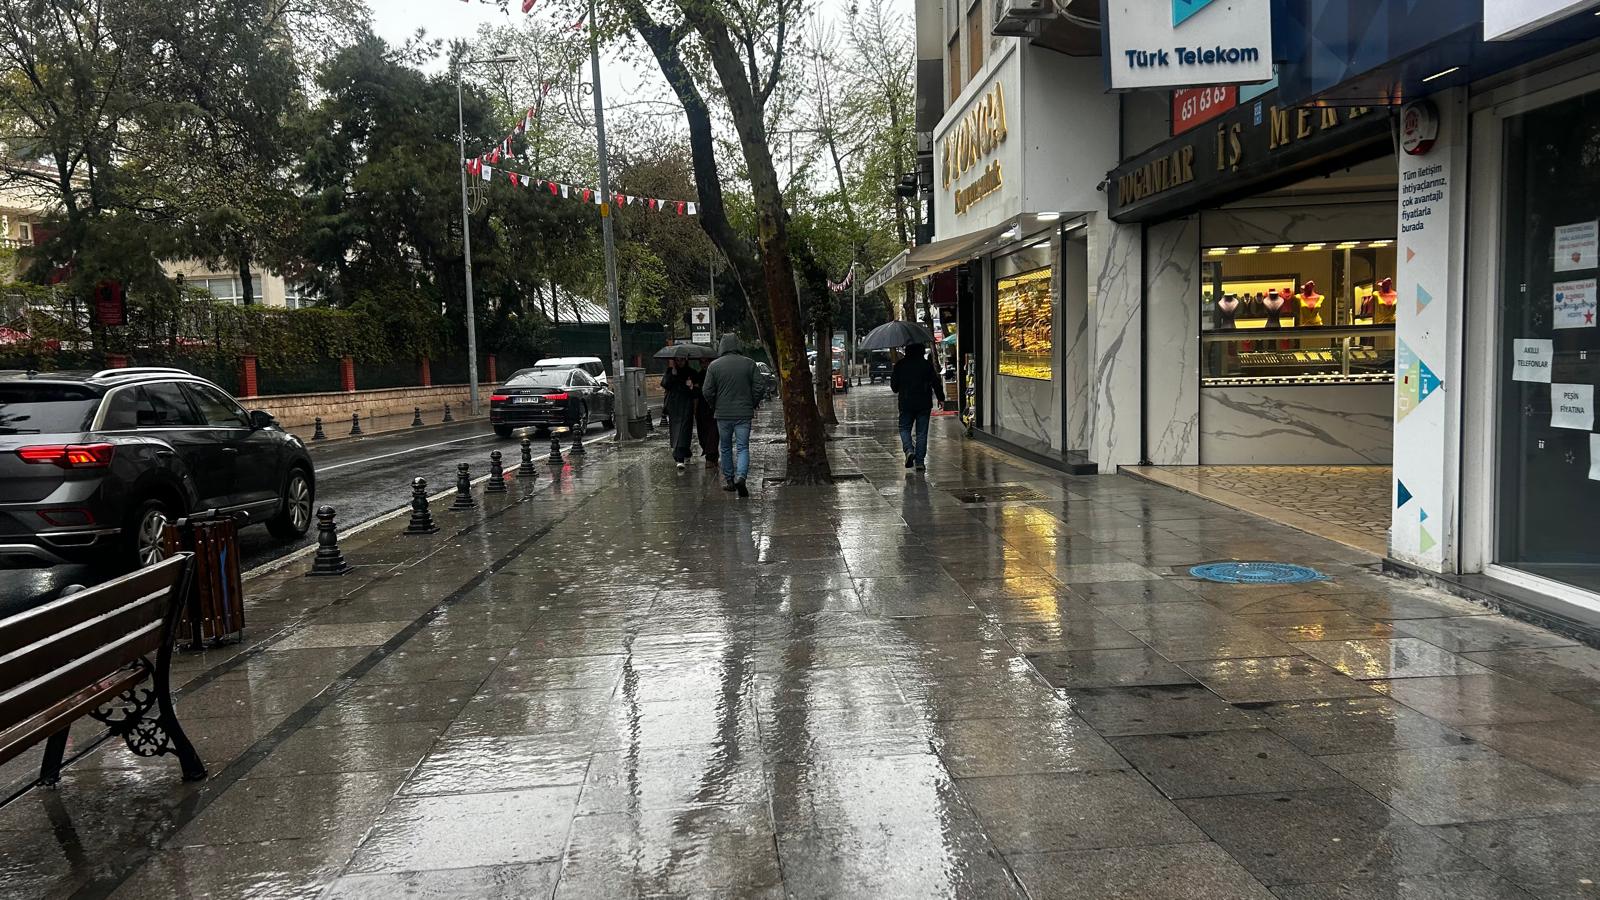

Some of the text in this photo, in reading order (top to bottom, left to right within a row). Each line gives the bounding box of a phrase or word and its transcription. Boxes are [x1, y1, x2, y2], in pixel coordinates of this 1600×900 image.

[1125, 46, 1259, 68] Türk Telekom
[1181, 96, 1196, 121] 651
[1199, 88, 1211, 112] 63
[1217, 122, 1242, 173] İŞ
[1402, 163, 1442, 181] Tüm iletişim
[1401, 189, 1443, 210] çok avantajlı
[1401, 206, 1431, 221] fiyatlarla
[1401, 220, 1424, 233] burada
[1517, 359, 1549, 368] TELEFONLAR
[1560, 404, 1585, 414] FİYATINA
